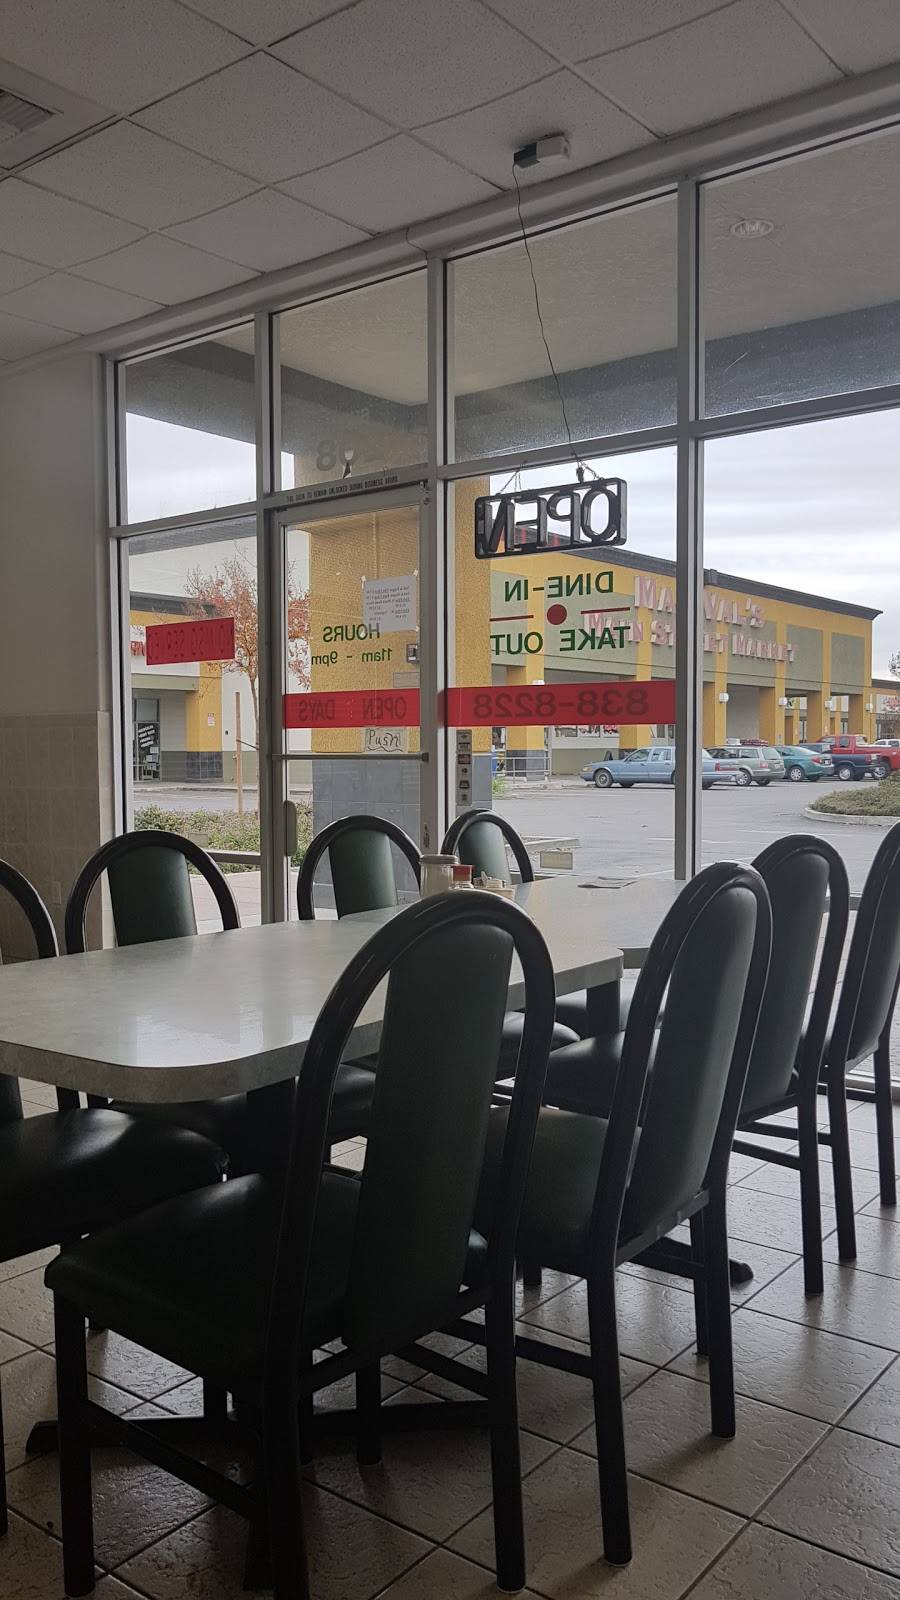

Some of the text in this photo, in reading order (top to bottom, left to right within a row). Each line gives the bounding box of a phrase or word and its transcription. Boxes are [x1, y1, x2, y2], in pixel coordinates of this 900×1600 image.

[650, 619, 728, 654] STET
[732, 632, 799, 663] MARKET
[368, 729, 401, 748] Push
